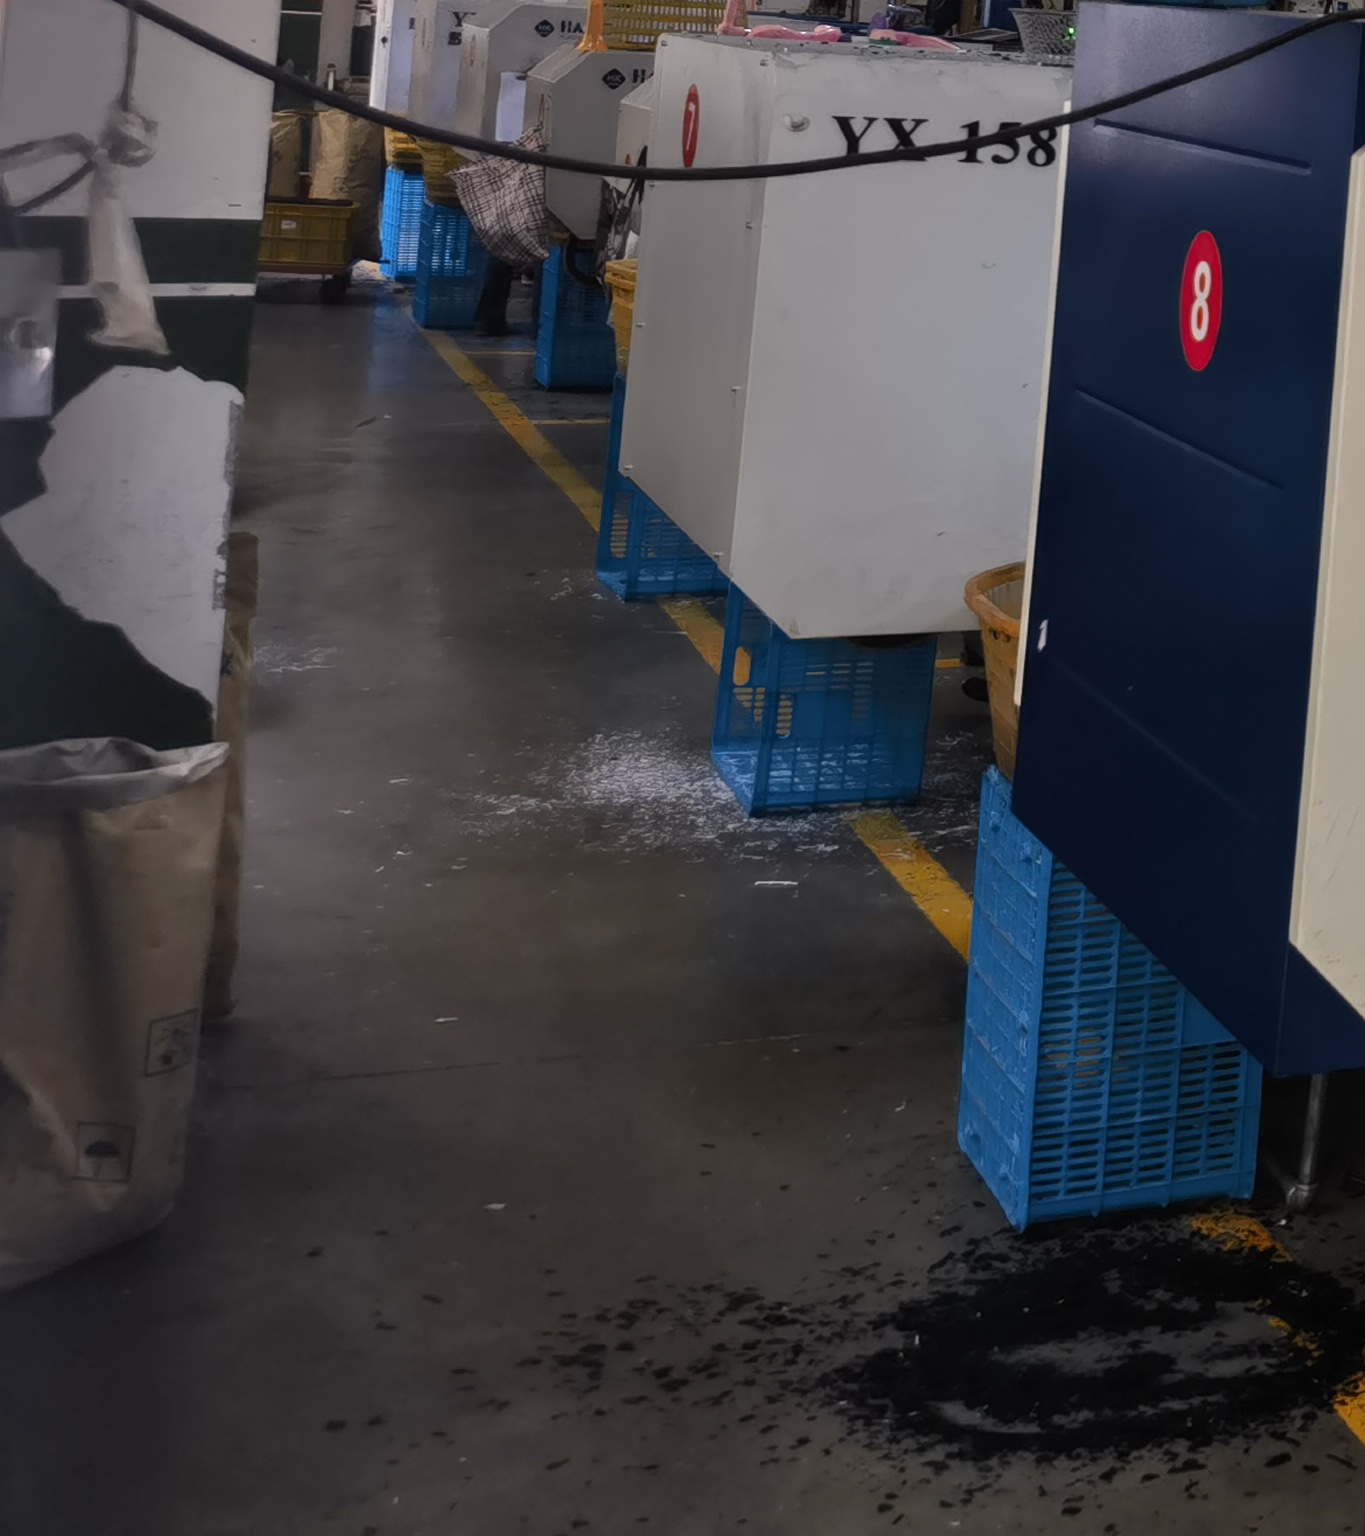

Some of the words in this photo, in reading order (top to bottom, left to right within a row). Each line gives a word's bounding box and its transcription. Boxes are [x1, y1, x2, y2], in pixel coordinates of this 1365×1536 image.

[832, 116, 930, 162] YX
[957, 120, 1058, 167] 158
[1190, 260, 1212, 342] 8
